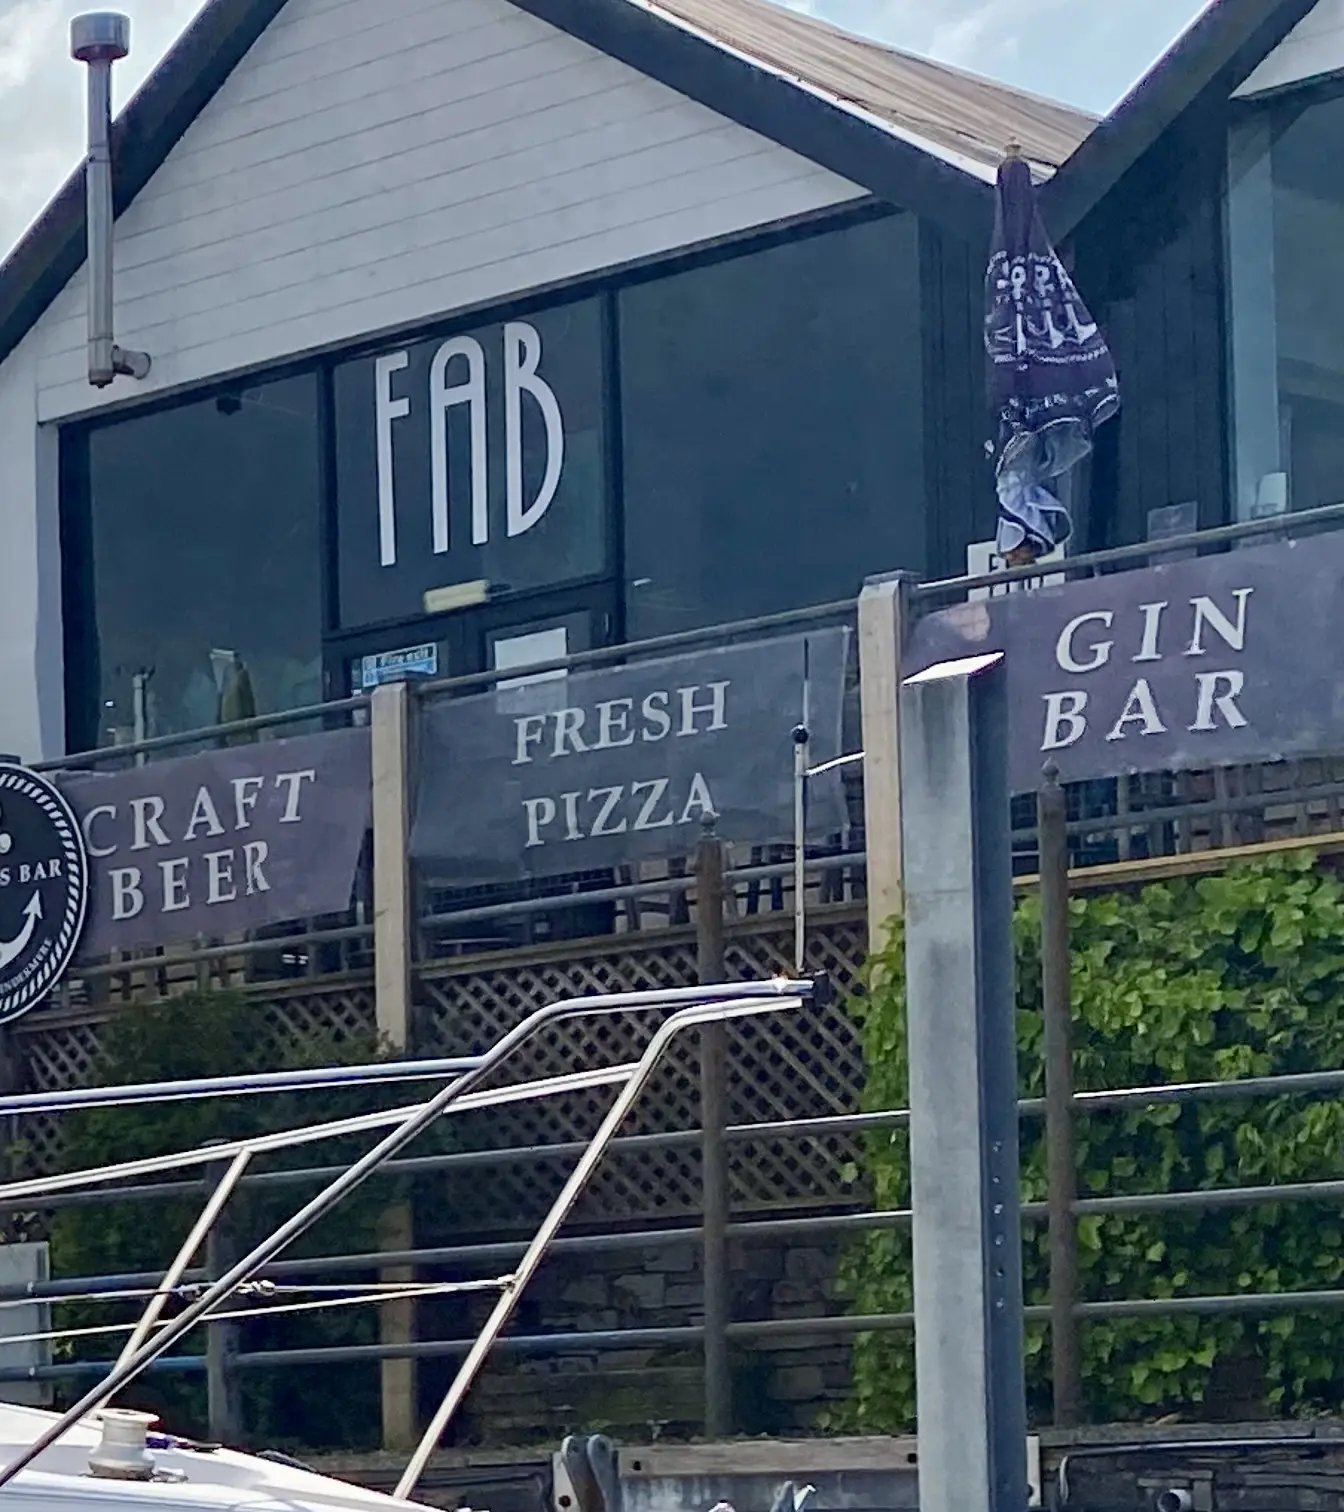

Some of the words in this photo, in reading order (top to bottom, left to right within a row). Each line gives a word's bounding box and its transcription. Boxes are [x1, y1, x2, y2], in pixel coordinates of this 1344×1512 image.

[375, 321, 564, 566] FAB
[1057, 588, 1254, 673] GIN
[512, 680, 731, 765] FRESH
[1041, 670, 1247, 752] BAR
[82, 769, 315, 857] CRAFT
[522, 771, 720, 848] PIZZA
[20, 858, 62, 883] BAR
[108, 840, 271, 920] BEER
